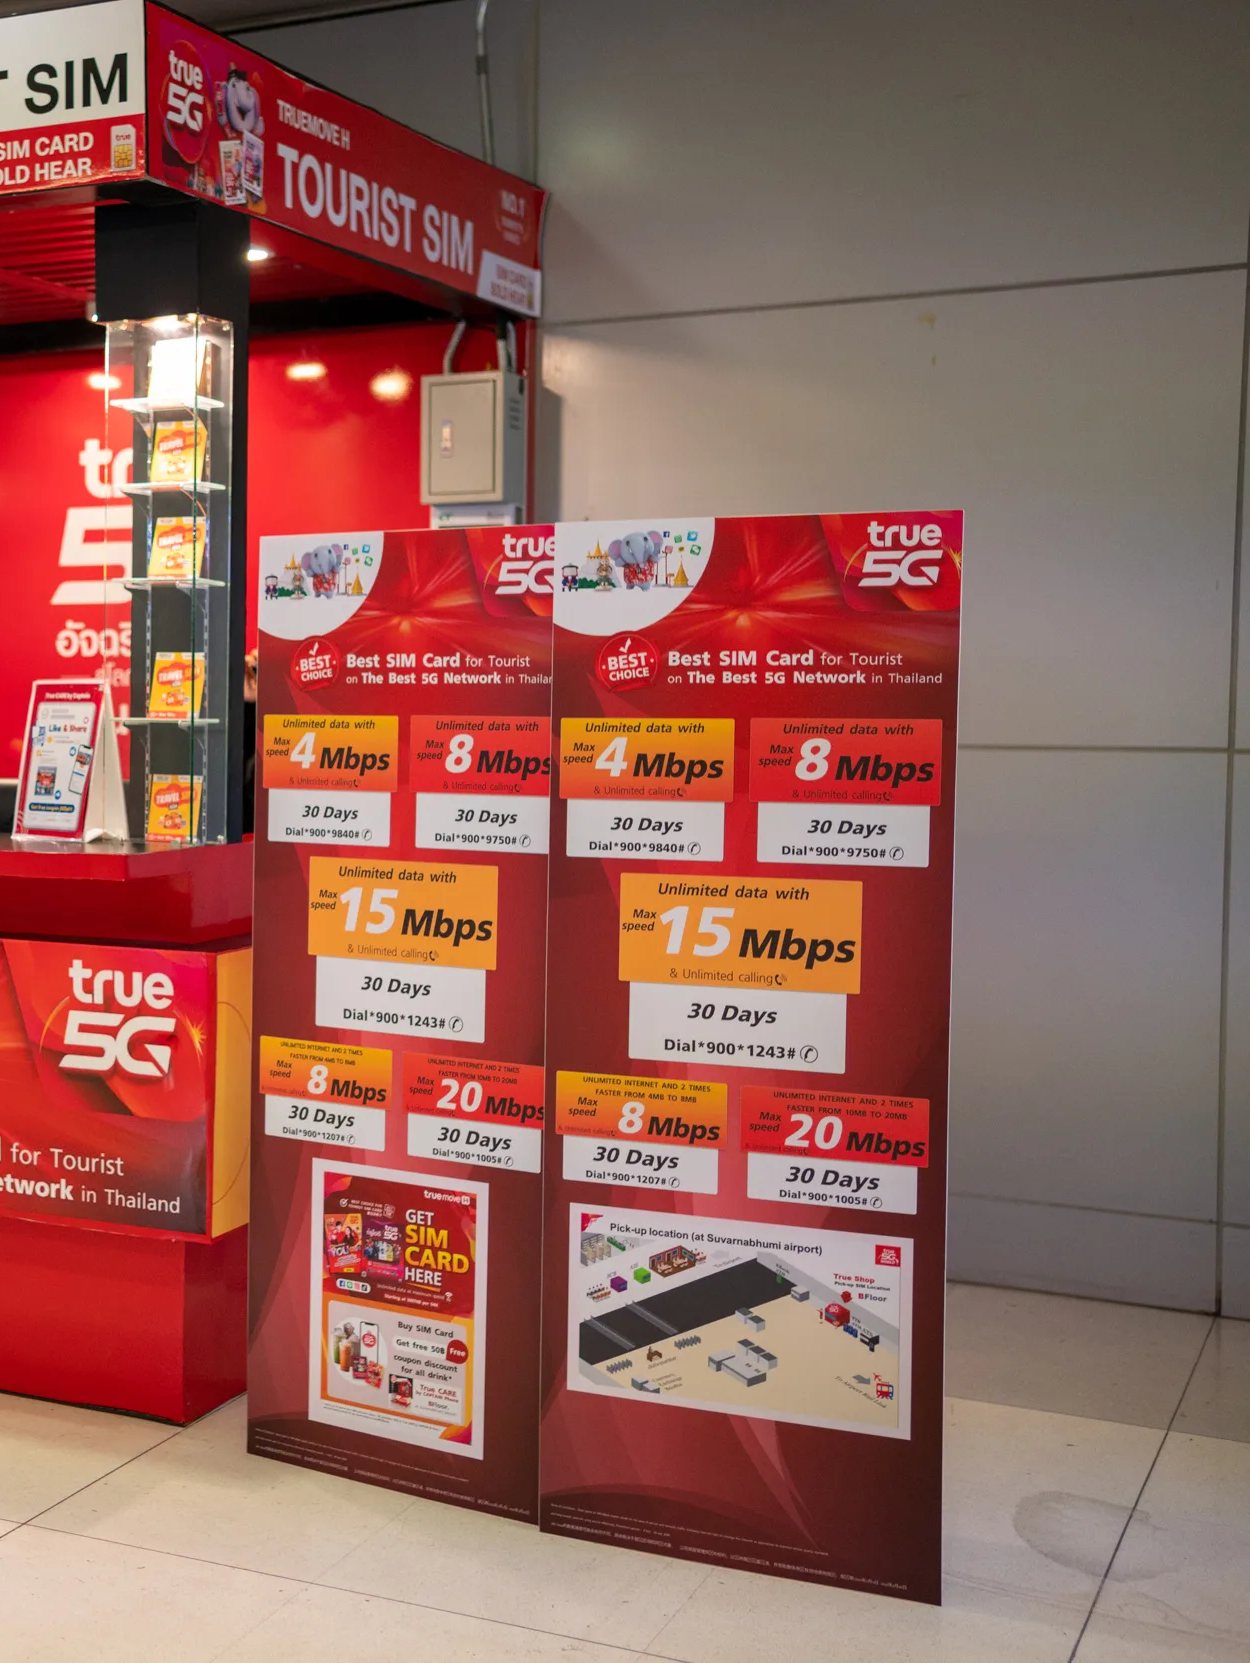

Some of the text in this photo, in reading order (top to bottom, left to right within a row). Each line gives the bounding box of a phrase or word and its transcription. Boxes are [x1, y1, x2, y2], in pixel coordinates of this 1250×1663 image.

[169, 50, 203, 90] true
[24, 52, 128, 114] SIM
[166, 84, 204, 132] 5G
[115, 133, 132, 141] true
[277, 100, 351, 150] TRUEMOVE H
[34, 132, 94, 155] CARD
[35, 158, 92, 181] HEAR
[277, 144, 474, 275] TOURIST SIM
[867, 520, 943, 548] true
[857, 549, 944, 587] 5G
[607, 651, 648, 671] BEST
[668, 650, 903, 667] Best SIM Card for Tourist
[608, 666, 650, 682] CHOICE
[667, 671, 943, 685] on The Best 5G Network in Thailand
[585, 721, 705, 734] Unlimited data with
[289, 731, 390, 776] 4 Mbps
[444, 734, 551, 781] 8 Mbps
[595, 736, 724, 785] 4 Mbps
[794, 738, 935, 789] 8 Mbps
[610, 816, 683, 833] 30 Days
[807, 819, 887, 838] 30 Days
[658, 882, 810, 901] Unlimited data with
[340, 886, 493, 947] 15 Mbps
[633, 908, 657, 920] Max
[621, 920, 655, 933] speed
[660, 905, 856, 970] 15 Mbps
[68, 959, 175, 1009] true
[669, 968, 773, 986] & Unlimited calling
[687, 1003, 778, 1027] 30 Days
[58, 1009, 176, 1079] 5G
[583, 1076, 622, 1086] UNLIMITED
[624, 1079, 659, 1088] INTERNET
[662, 1082, 679, 1090] AND
[689, 1084, 711, 1092] TIMES
[773, 1091, 914, 1109] UNLIMITED INTERNET AND 2 TIMES
[787, 1103, 908, 1121] FASTER FROM 10MB TO 20MB
[617, 1101, 720, 1145] 8 Mbps
[784, 1113, 926, 1161] 20 Mbps
[10, 1141, 41, 1165] for
[49, 1147, 124, 1177] Tourist
[593, 1146, 679, 1170] 30 Days
[785, 1167, 880, 1191] 30 Days
[81, 1184, 97, 1205] in
[103, 1187, 181, 1215] Thailand
[406, 1209, 434, 1226] GET
[405, 1224, 448, 1249] SIM
[610, 1223, 823, 1257] Pick-up location (at Suvarnabhumi airport)
[405, 1246, 469, 1273] CARD
[405, 1267, 442, 1286] HERE
[834, 1273, 875, 1285] True Shop
[398, 1321, 453, 1338] Buy SIM Card
[396, 1339, 410, 1347] Get
[413, 1342, 428, 1351] free
[450, 1348, 466, 1357] Free
[394, 1355, 458, 1373] coupon discount
